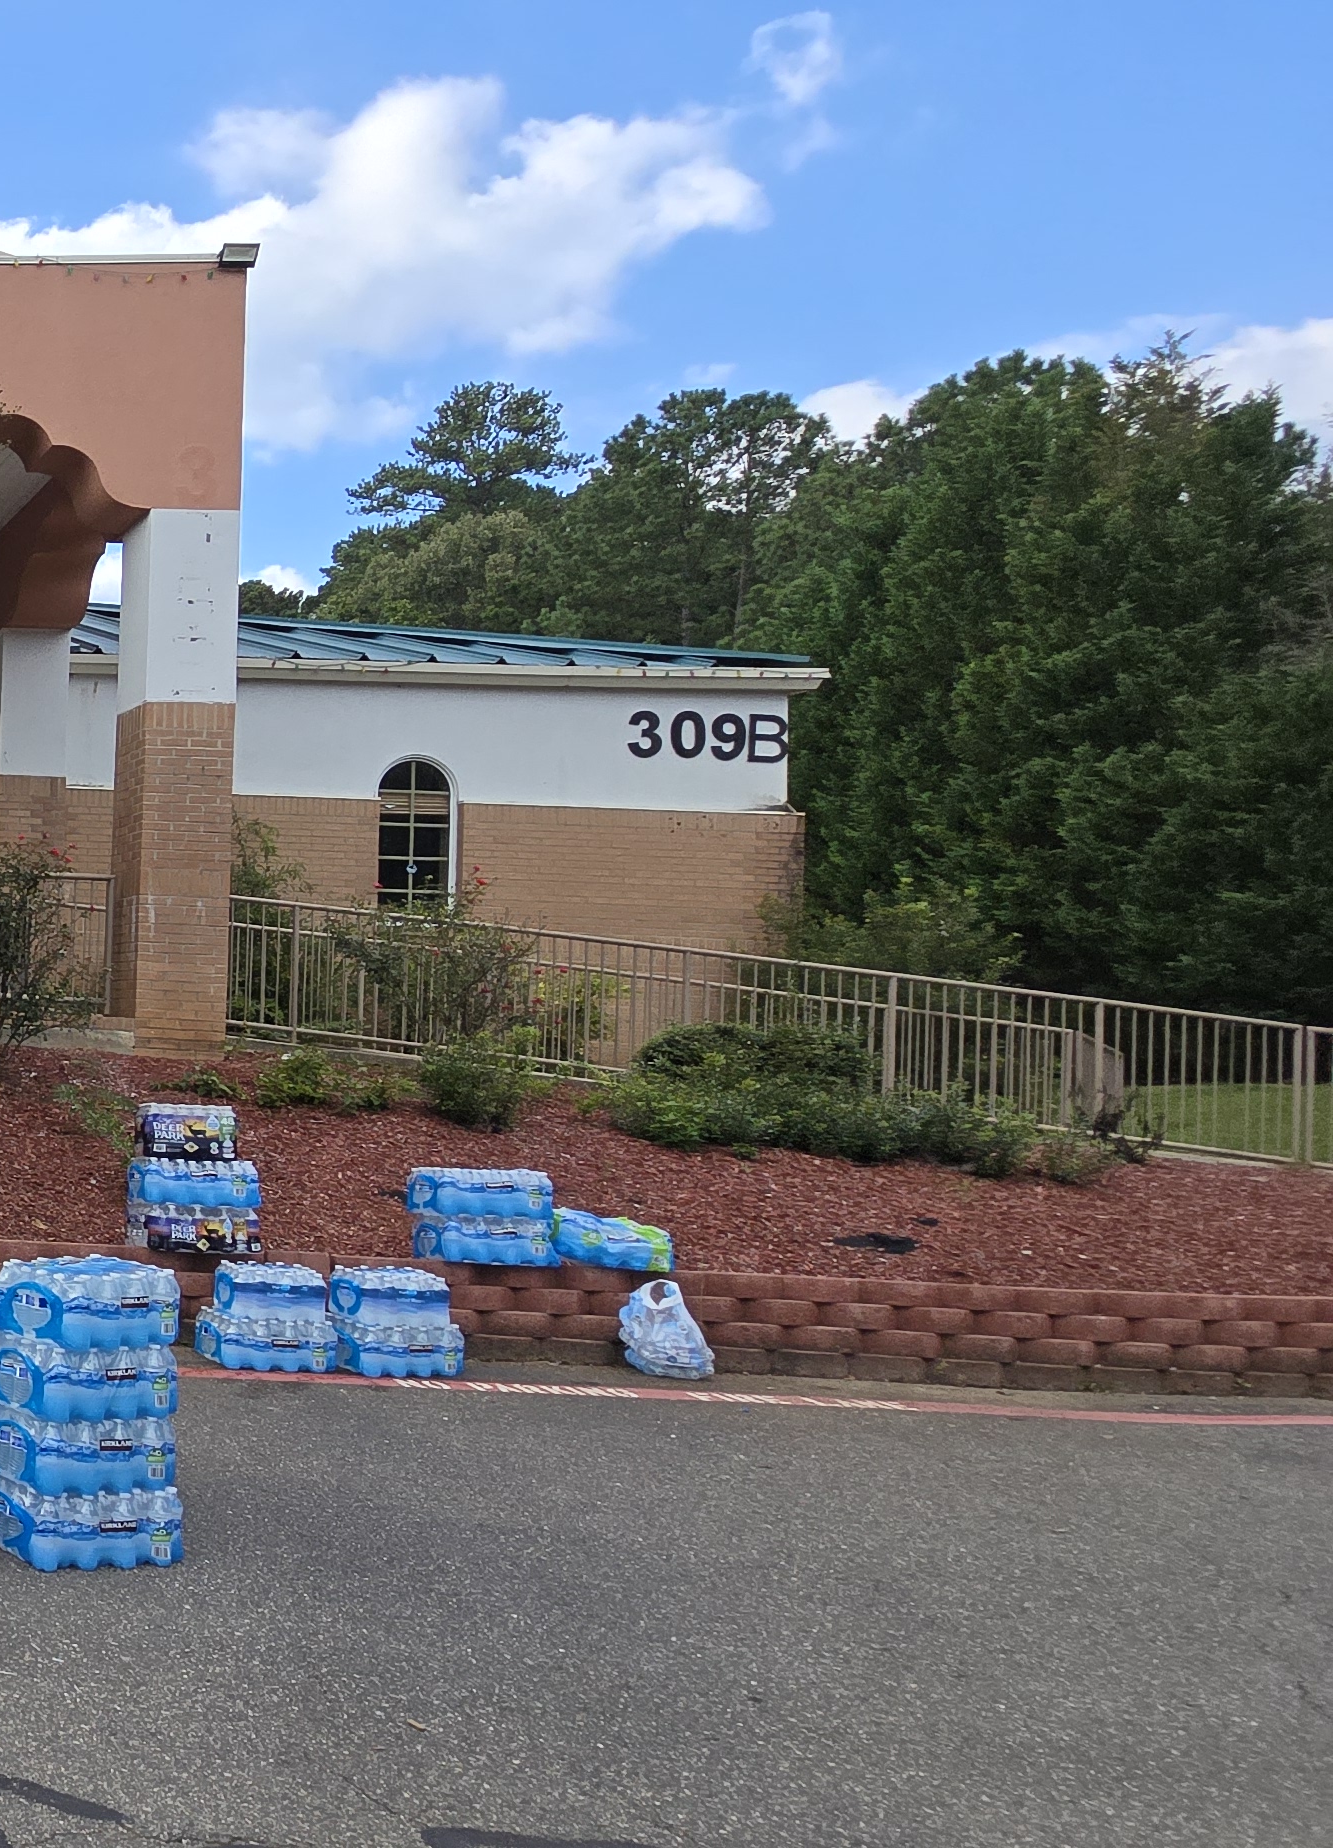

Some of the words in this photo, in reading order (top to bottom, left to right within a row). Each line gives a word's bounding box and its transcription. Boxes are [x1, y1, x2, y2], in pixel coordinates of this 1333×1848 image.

[627, 710, 789, 764] 309B
[153, 1121, 185, 1131] DEER
[154, 1129, 186, 1141] PARK
[171, 1223, 196, 1233] DEER
[171, 1231, 197, 1241] PARK
[106, 1369, 136, 1377] KIRKLAN
[393, 1378, 452, 1390] NO
[465, 1382, 640, 1399] PARKING
